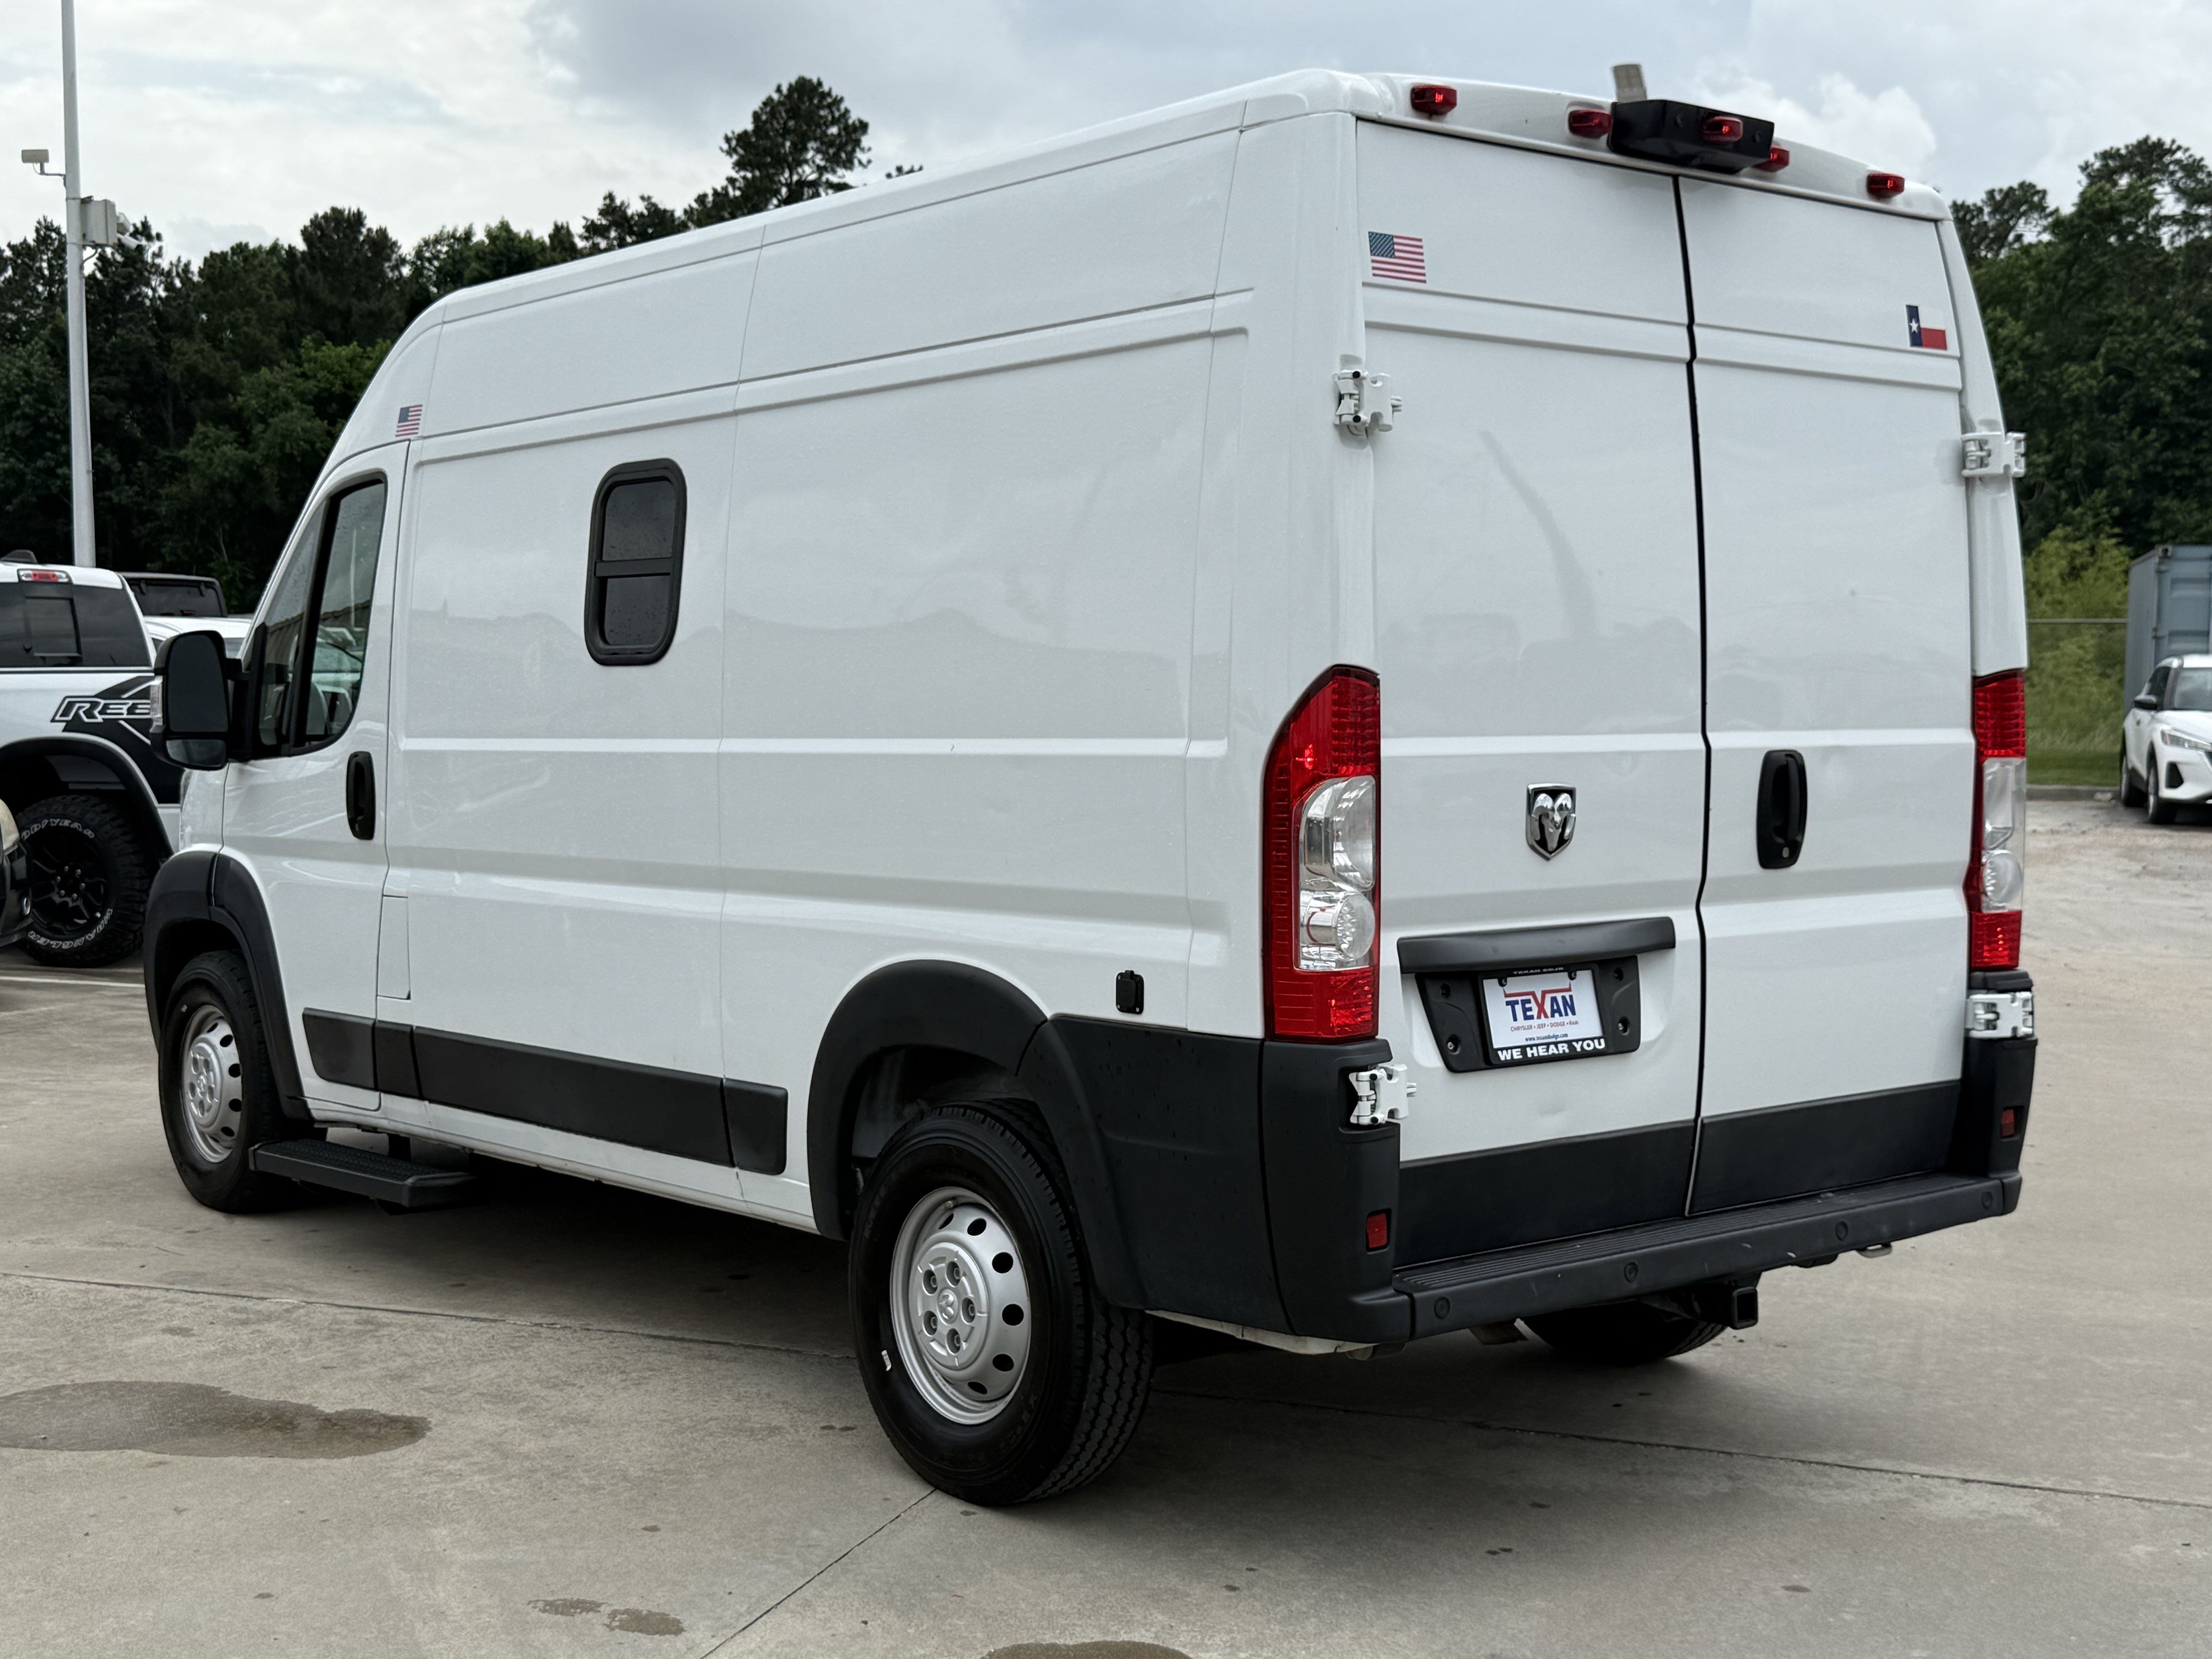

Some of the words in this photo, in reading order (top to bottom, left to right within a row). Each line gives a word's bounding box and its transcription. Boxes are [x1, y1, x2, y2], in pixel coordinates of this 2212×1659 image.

[1503, 983, 1576, 1022] TEXAN
[1498, 1048, 1522, 1060] WE
[1527, 1043, 1569, 1057] HEAR
[1572, 1039, 1605, 1051] YOU
